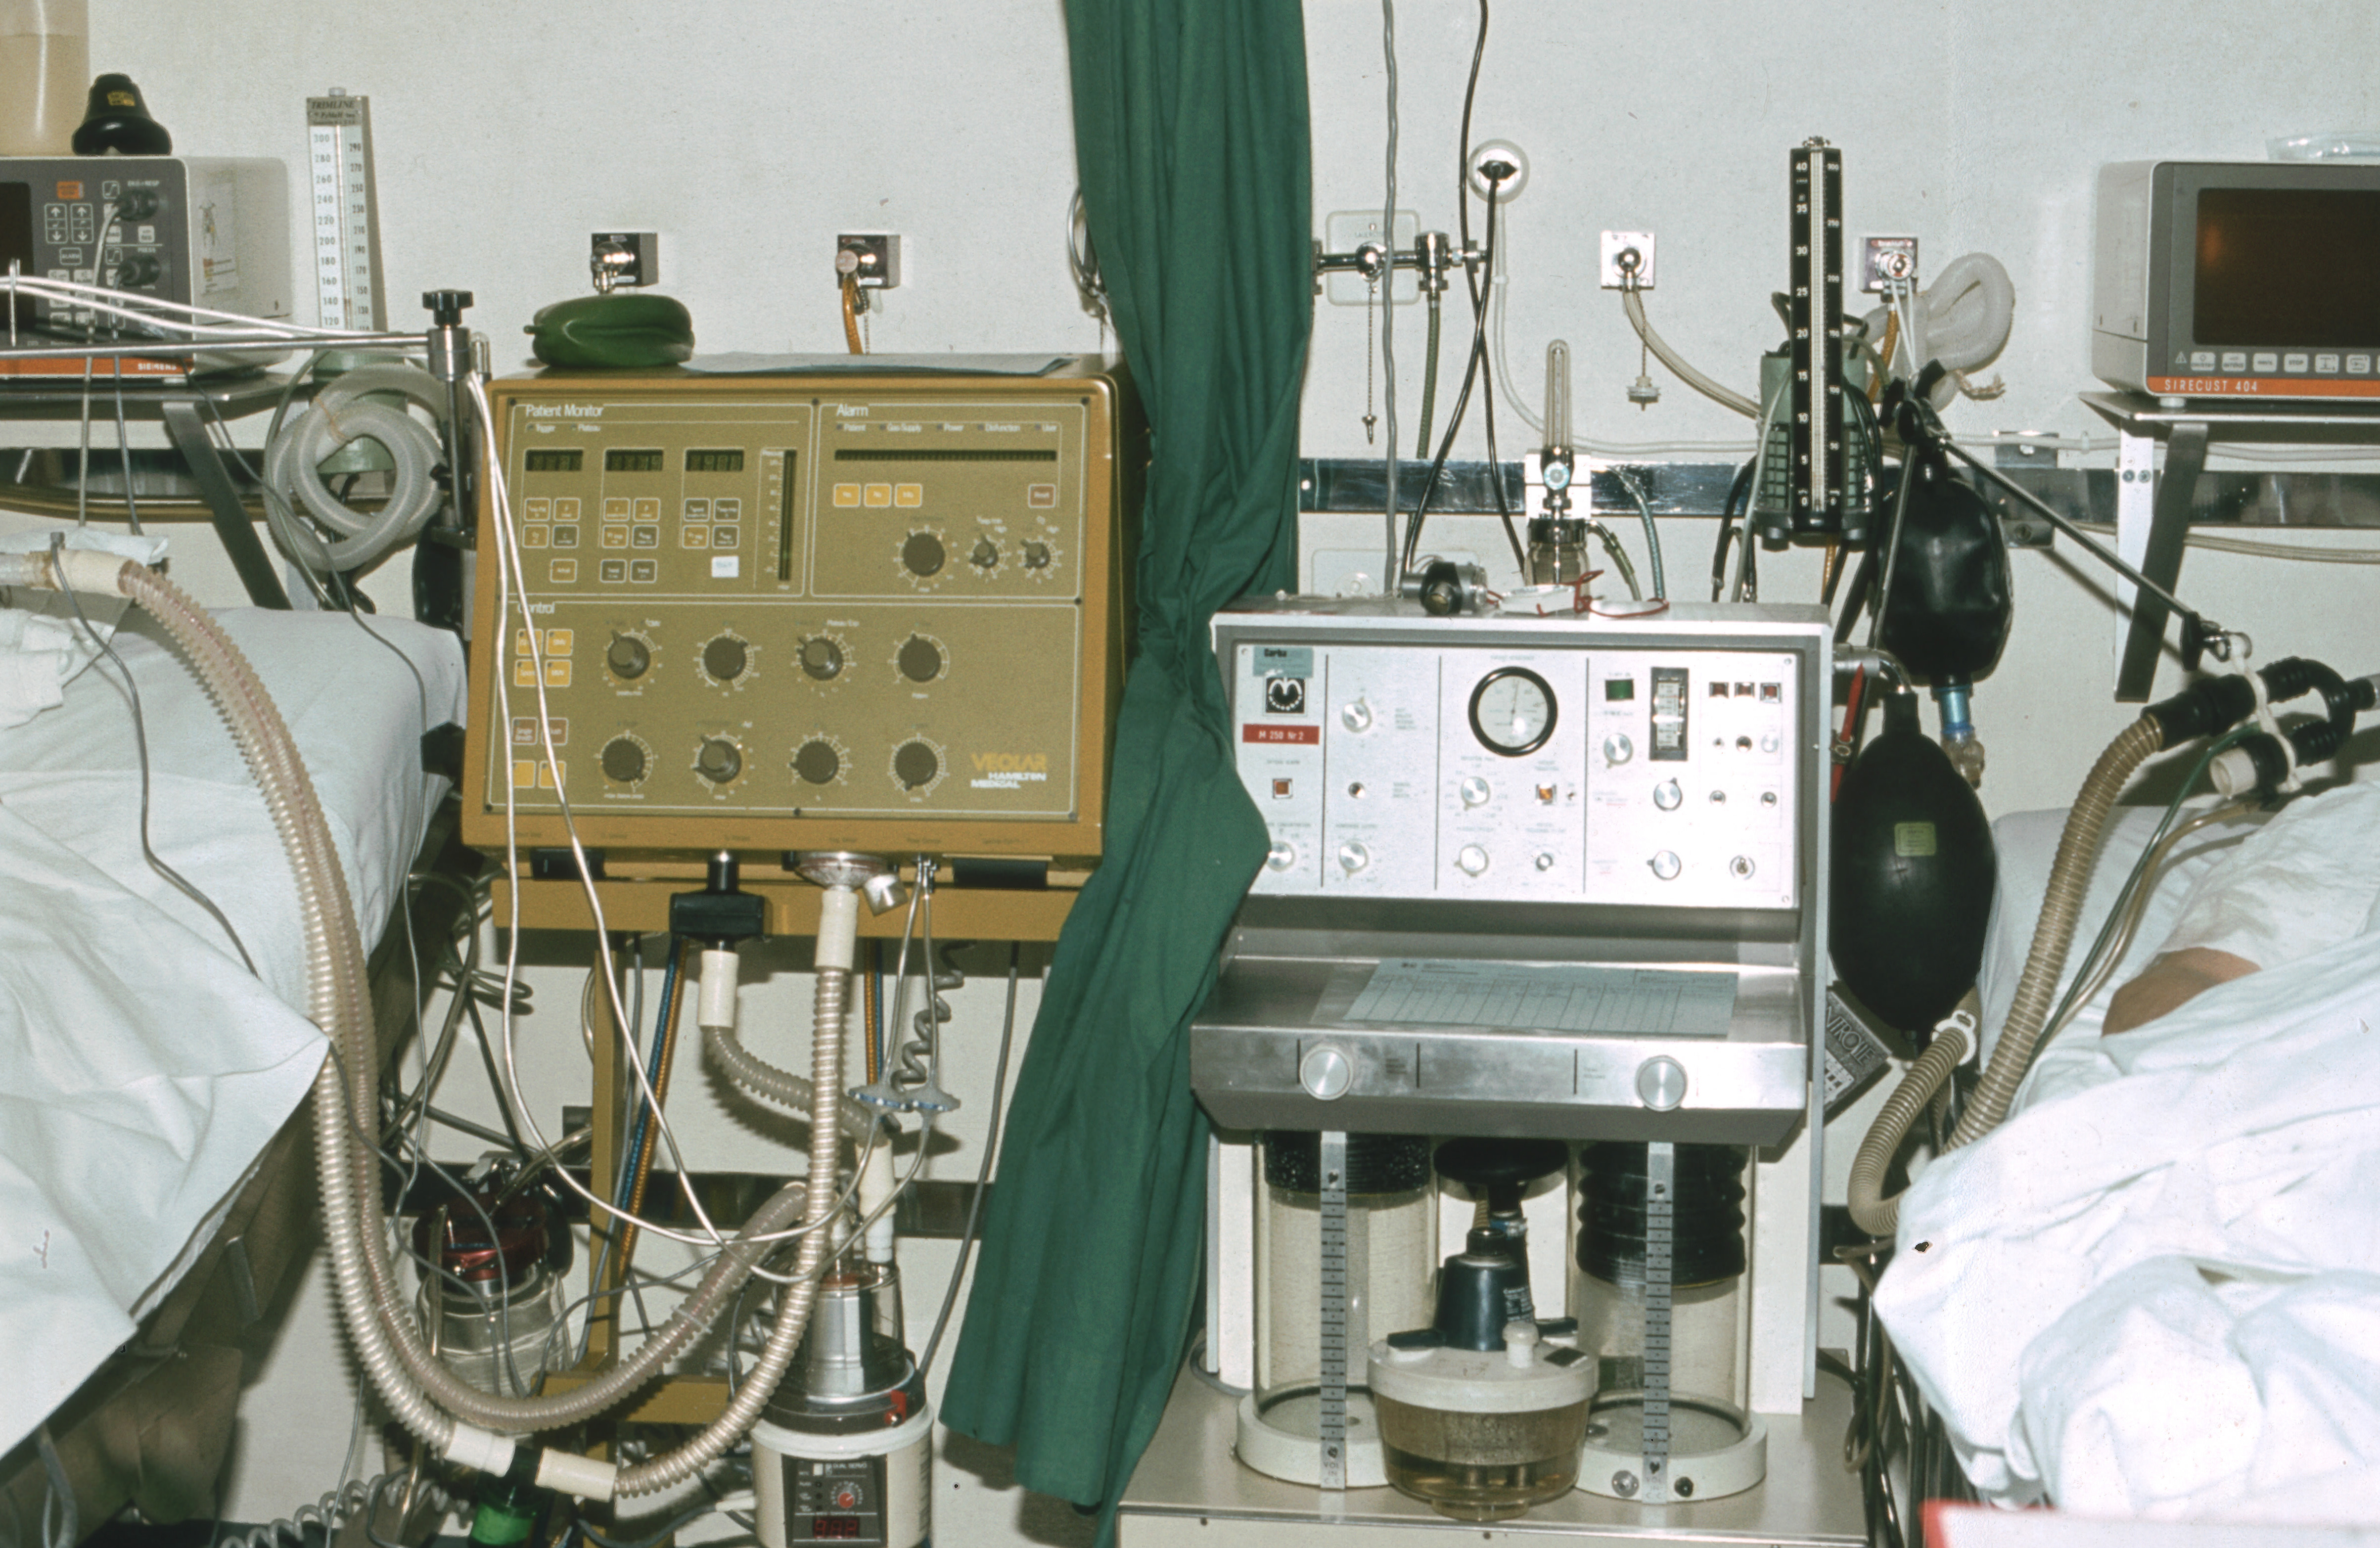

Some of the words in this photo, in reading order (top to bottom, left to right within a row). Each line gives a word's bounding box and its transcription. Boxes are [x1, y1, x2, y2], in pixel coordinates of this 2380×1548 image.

[312, 100, 355, 109] TRIMLINE
[314, 134, 330, 143] 300
[349, 143, 362, 152] 290
[315, 154, 331, 163] 280
[351, 163, 362, 172] 270
[1796, 162, 1808, 171] 40
[316, 175, 332, 183] 260
[352, 183, 364, 192] 250
[317, 195, 333, 204] 240
[352, 205, 365, 213] 230
[1796, 203, 1808, 213] 35
[318, 217, 334, 225] 220
[319, 236, 335, 245] 200
[1796, 246, 1808, 255] 30
[322, 277, 337, 285] 160
[357, 286, 367, 294] 150
[1796, 287, 1808, 296] 25
[324, 317, 339, 325] 120
[1796, 328, 1808, 338] 20
[1797, 370, 1808, 381] 15
[2164, 379, 2228, 391] SIRECUST
[2235, 381, 2257, 392] 404
[526, 405, 562, 417] Patient
[564, 404, 604, 417] Monitor
[836, 403, 869, 416] Alarm
[1798, 413, 1808, 423] 10
[944, 423, 964, 432] Power
[1830, 442, 1839, 450] 50
[1800, 454, 1808, 464] 5
[1801, 496, 1808, 506] 0
[1831, 497, 1836, 505] 0
[517, 602, 555, 614] Cntrol
[1258, 730, 1266, 739] M
[1270, 730, 1283, 740] 250
[1287, 731, 1297, 740] Nr
[1298, 731, 1304, 740] 2
[971, 752, 1047, 771] VEOLAR
[988, 772, 1047, 781] HAMILTON
[970, 779, 1021, 789] MEDICAL
